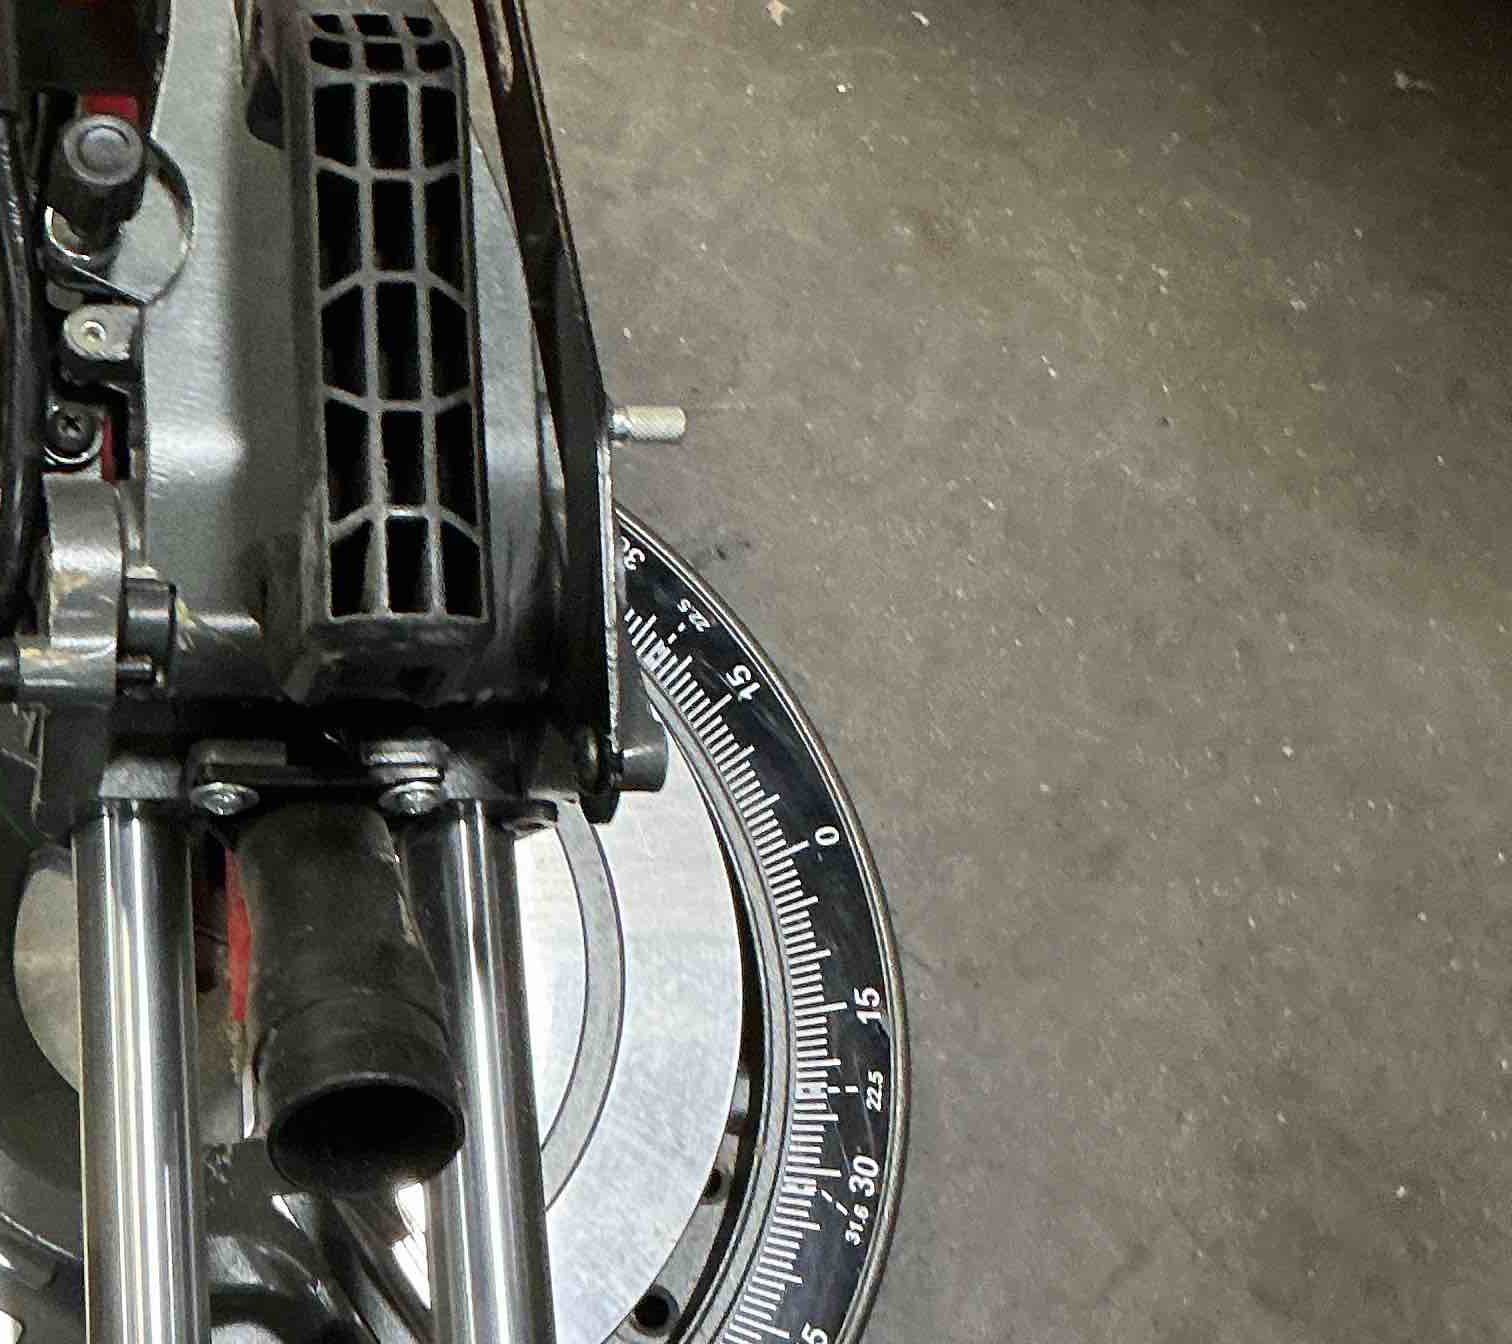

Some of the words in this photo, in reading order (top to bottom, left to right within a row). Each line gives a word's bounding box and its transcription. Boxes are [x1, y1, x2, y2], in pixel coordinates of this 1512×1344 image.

[725, 664, 760, 701] 15
[814, 825, 840, 847] 0
[854, 987, 882, 1026] 15
[865, 1070, 885, 1112] 22.5
[847, 1156, 879, 1197] 30
[845, 1204, 870, 1246] 31.6
